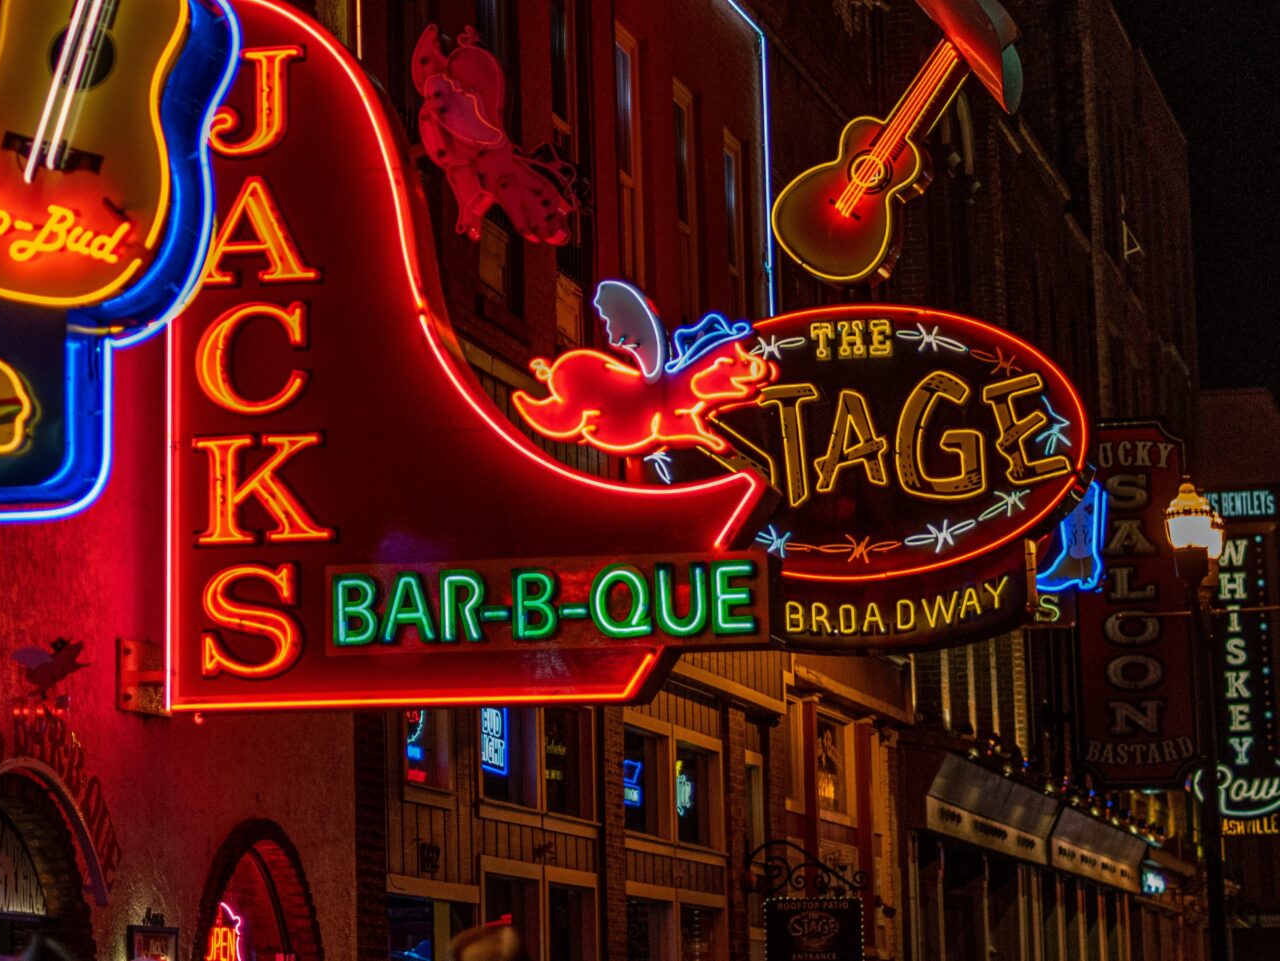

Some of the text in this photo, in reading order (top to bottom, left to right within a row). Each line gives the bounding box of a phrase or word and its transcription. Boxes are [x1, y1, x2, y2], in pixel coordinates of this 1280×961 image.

[193, 44, 332, 681] JACKS
[809, 318, 894, 361] THE
[1097, 440, 1175, 471] UCKY
[331, 558, 756, 647] BAR-B-QUE
[785, 576, 1008, 635] BROADWAY
[1103, 473, 1162, 735] SALOON
[1218, 540, 1254, 767] WHISKEY
[1086, 737, 1195, 766] BASTARD
[1221, 812, 1280, 837] ASHVILLE
